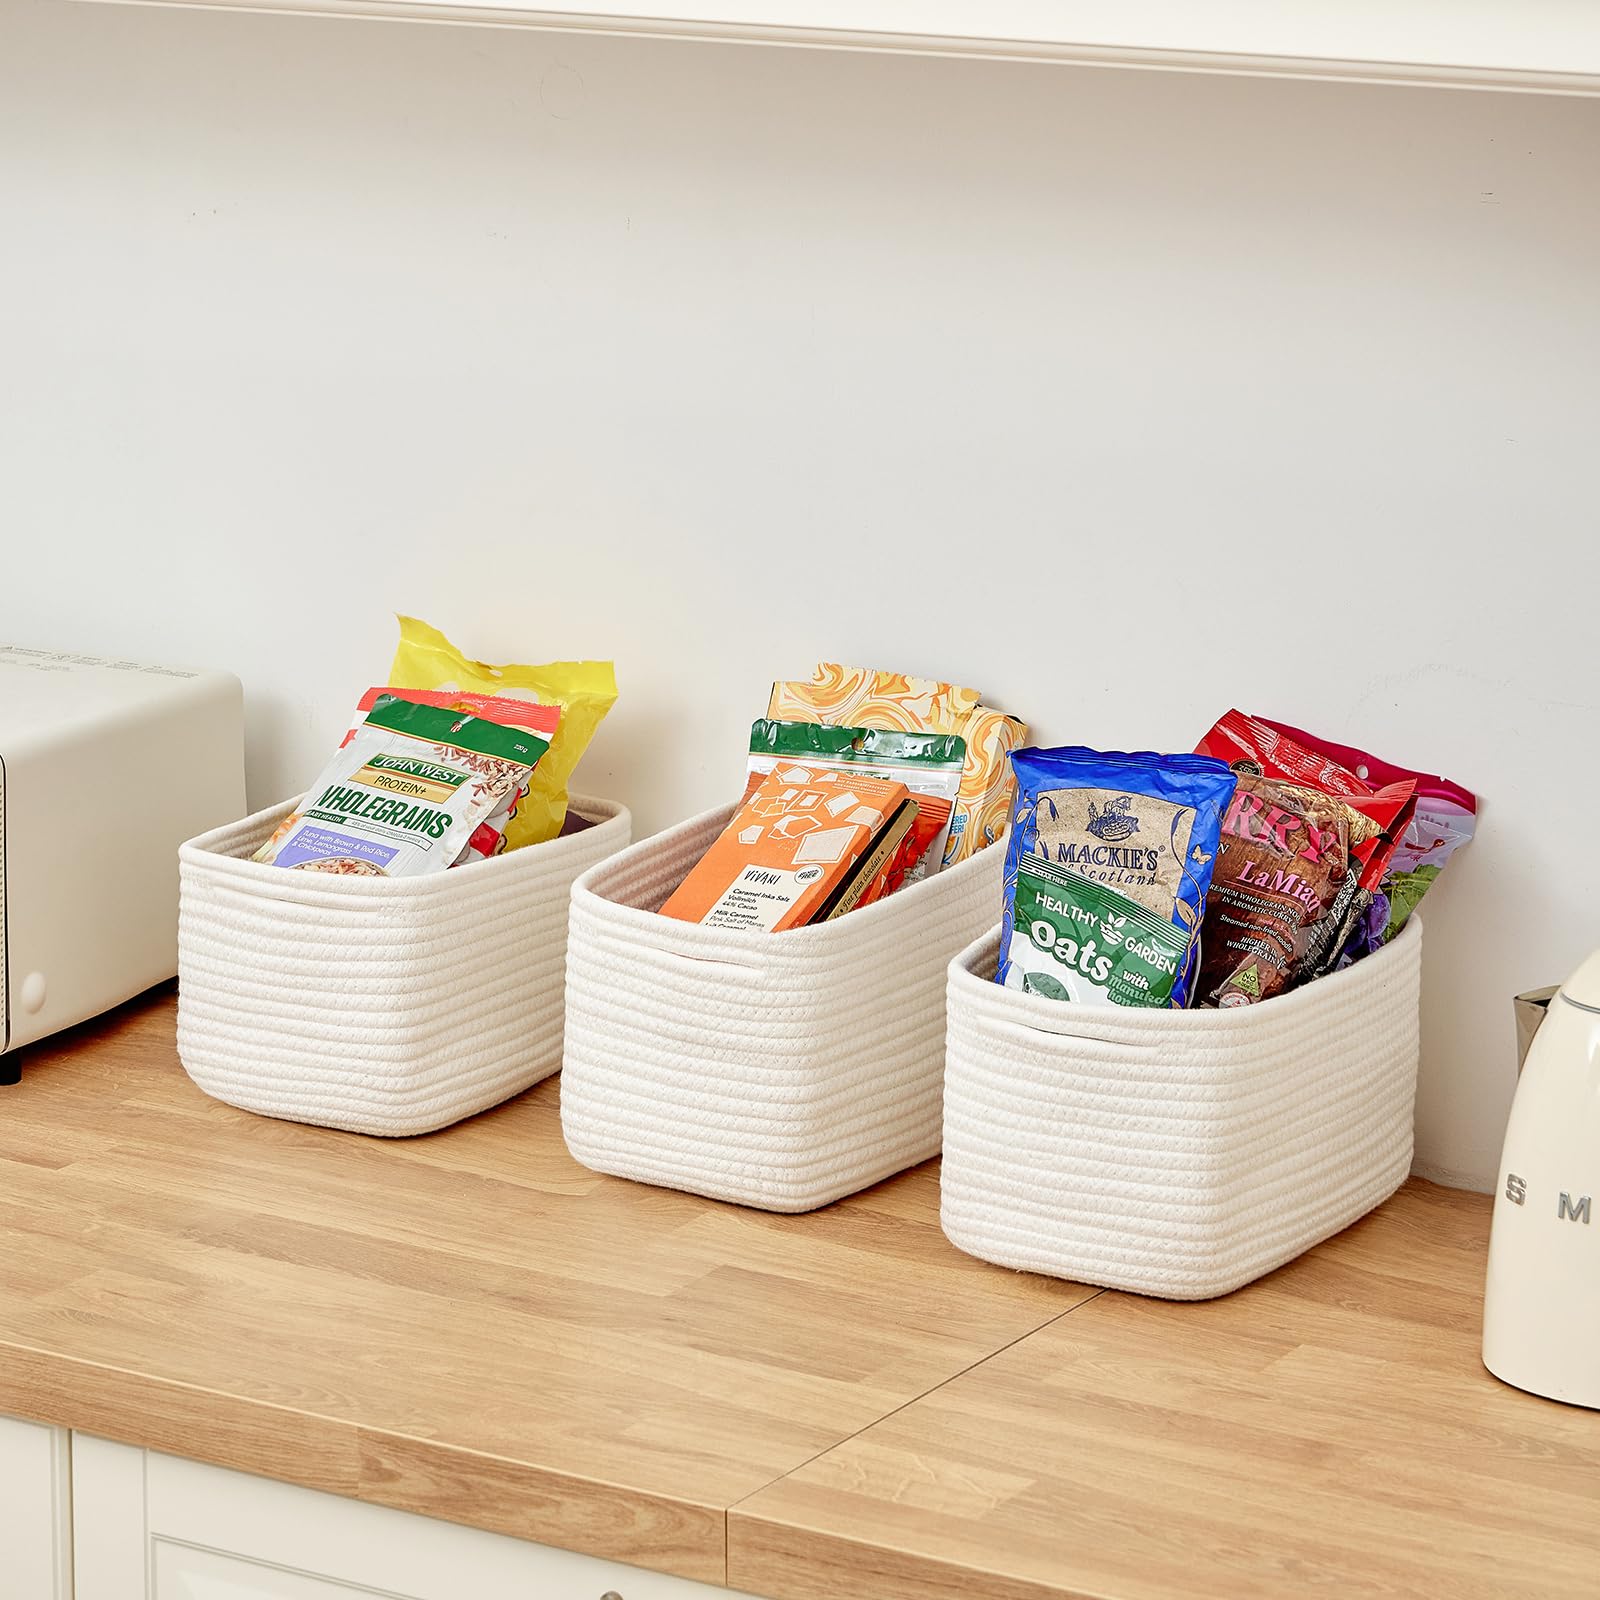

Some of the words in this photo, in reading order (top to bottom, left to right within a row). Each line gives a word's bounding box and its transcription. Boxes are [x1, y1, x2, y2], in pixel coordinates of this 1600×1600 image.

[374, 756, 419, 772] JOHN
[418, 764, 464, 783] WEST
[374, 775, 427, 795] PROTEIN+
[321, 813, 344, 824] HEALTH
[298, 842, 332, 856] Chickpeas
[303, 830, 319, 839] Tuna
[319, 833, 333, 843] with
[333, 838, 354, 848] Brown
[361, 844, 375, 853] Red
[314, 839, 353, 855] Lemongrass
[852, 880, 865, 898] plain
[862, 855, 882, 882] chocolate
[1079, 865, 1157, 886] Scotland
[732, 888, 762, 899] Caramel
[761, 892, 776, 900] Inka
[776, 895, 791, 903] Salz
[1208, 884, 1240, 897] REMIUM
[1240, 891, 1286, 911] WHOLEGRAIN
[729, 911, 760, 920] Caramel
[737, 902, 758, 911] Cacao
[1036, 892, 1099, 927] HEALTHY
[1230, 898, 1270, 915] AROMATIC
[1268, 910, 1293, 924] CURRY
[1220, 914, 1248, 928] Steamed
[1248, 923, 1278, 938] non-fried
[1226, 940, 1278, 965] WHOLEGRAIN
[1240, 936, 1271, 952] HIGHER
[1124, 936, 1177, 975] GARDEN
[1122, 970, 1149, 991] with
[1241, 972, 1257, 983] NO
